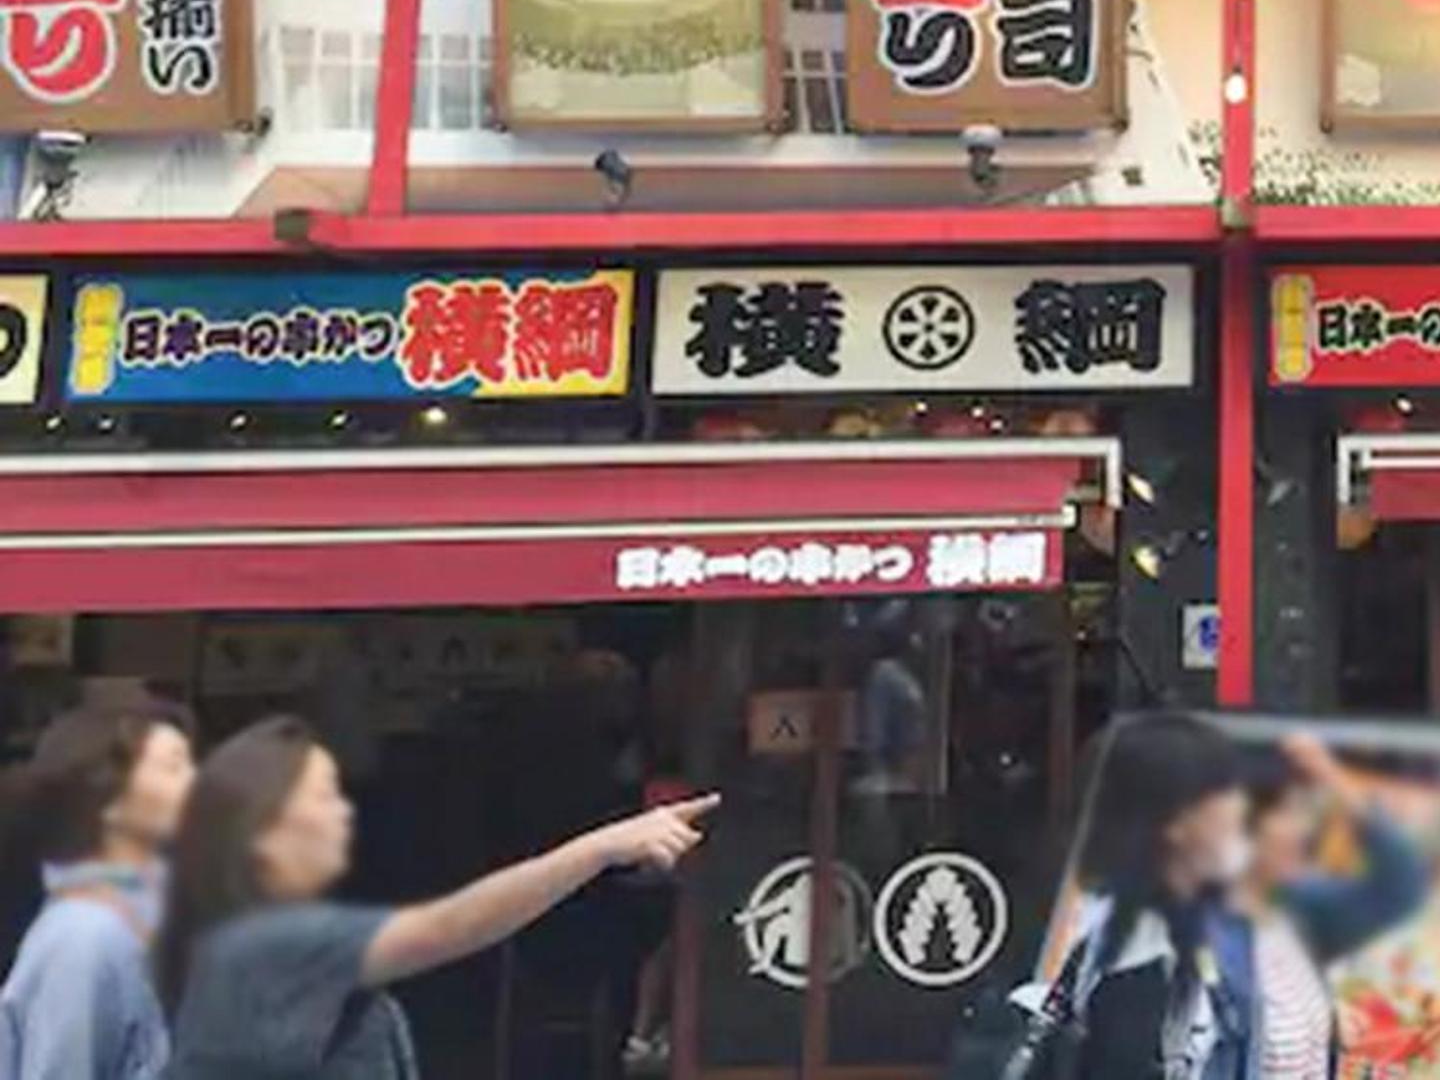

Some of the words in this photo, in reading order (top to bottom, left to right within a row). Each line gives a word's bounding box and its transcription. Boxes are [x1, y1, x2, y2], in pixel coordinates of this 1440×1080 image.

[124, 313, 397, 363] 日本一の串かつ
[402, 284, 618, 382] 横綱
[616, 544, 913, 588] 日本一の串かつ
